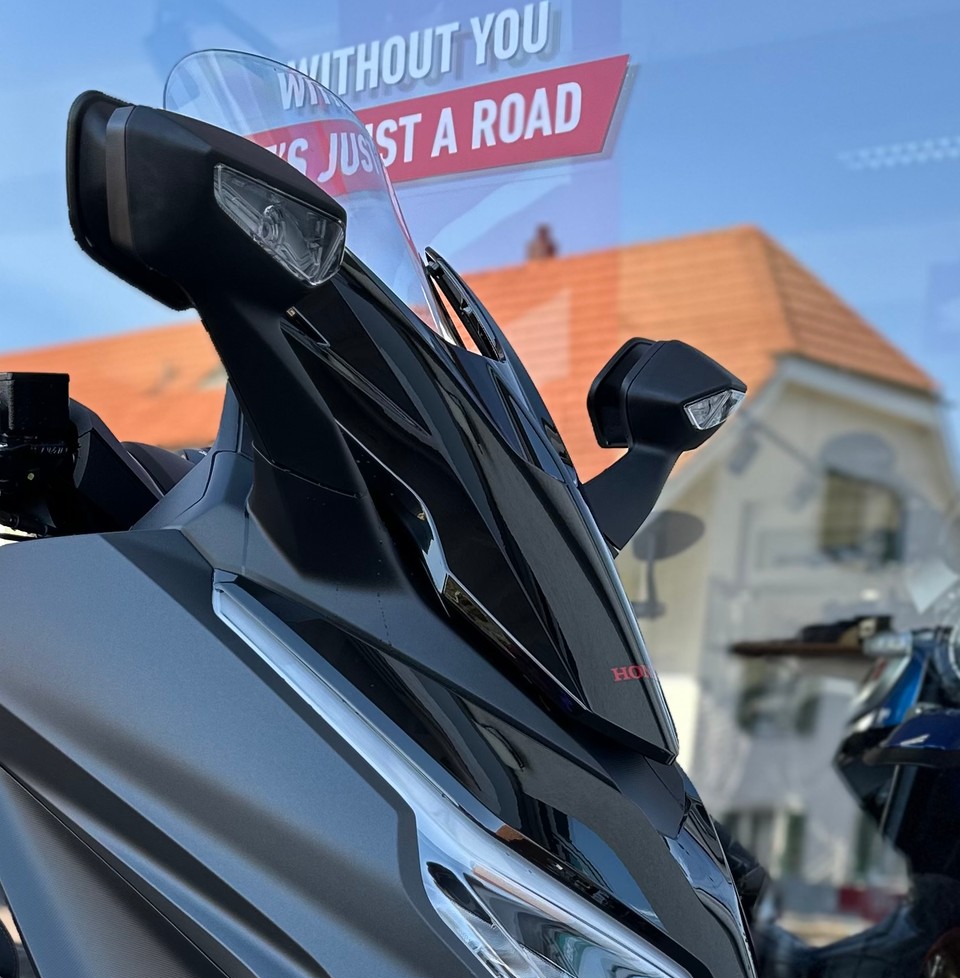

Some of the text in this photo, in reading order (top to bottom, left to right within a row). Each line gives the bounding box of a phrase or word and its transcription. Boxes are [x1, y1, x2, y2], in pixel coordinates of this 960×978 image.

[277, 0, 549, 110] WITHOUT YOU
[317, 112, 422, 183] JUST
[430, 106, 458, 158] A
[471, 81, 582, 150] ROAD
